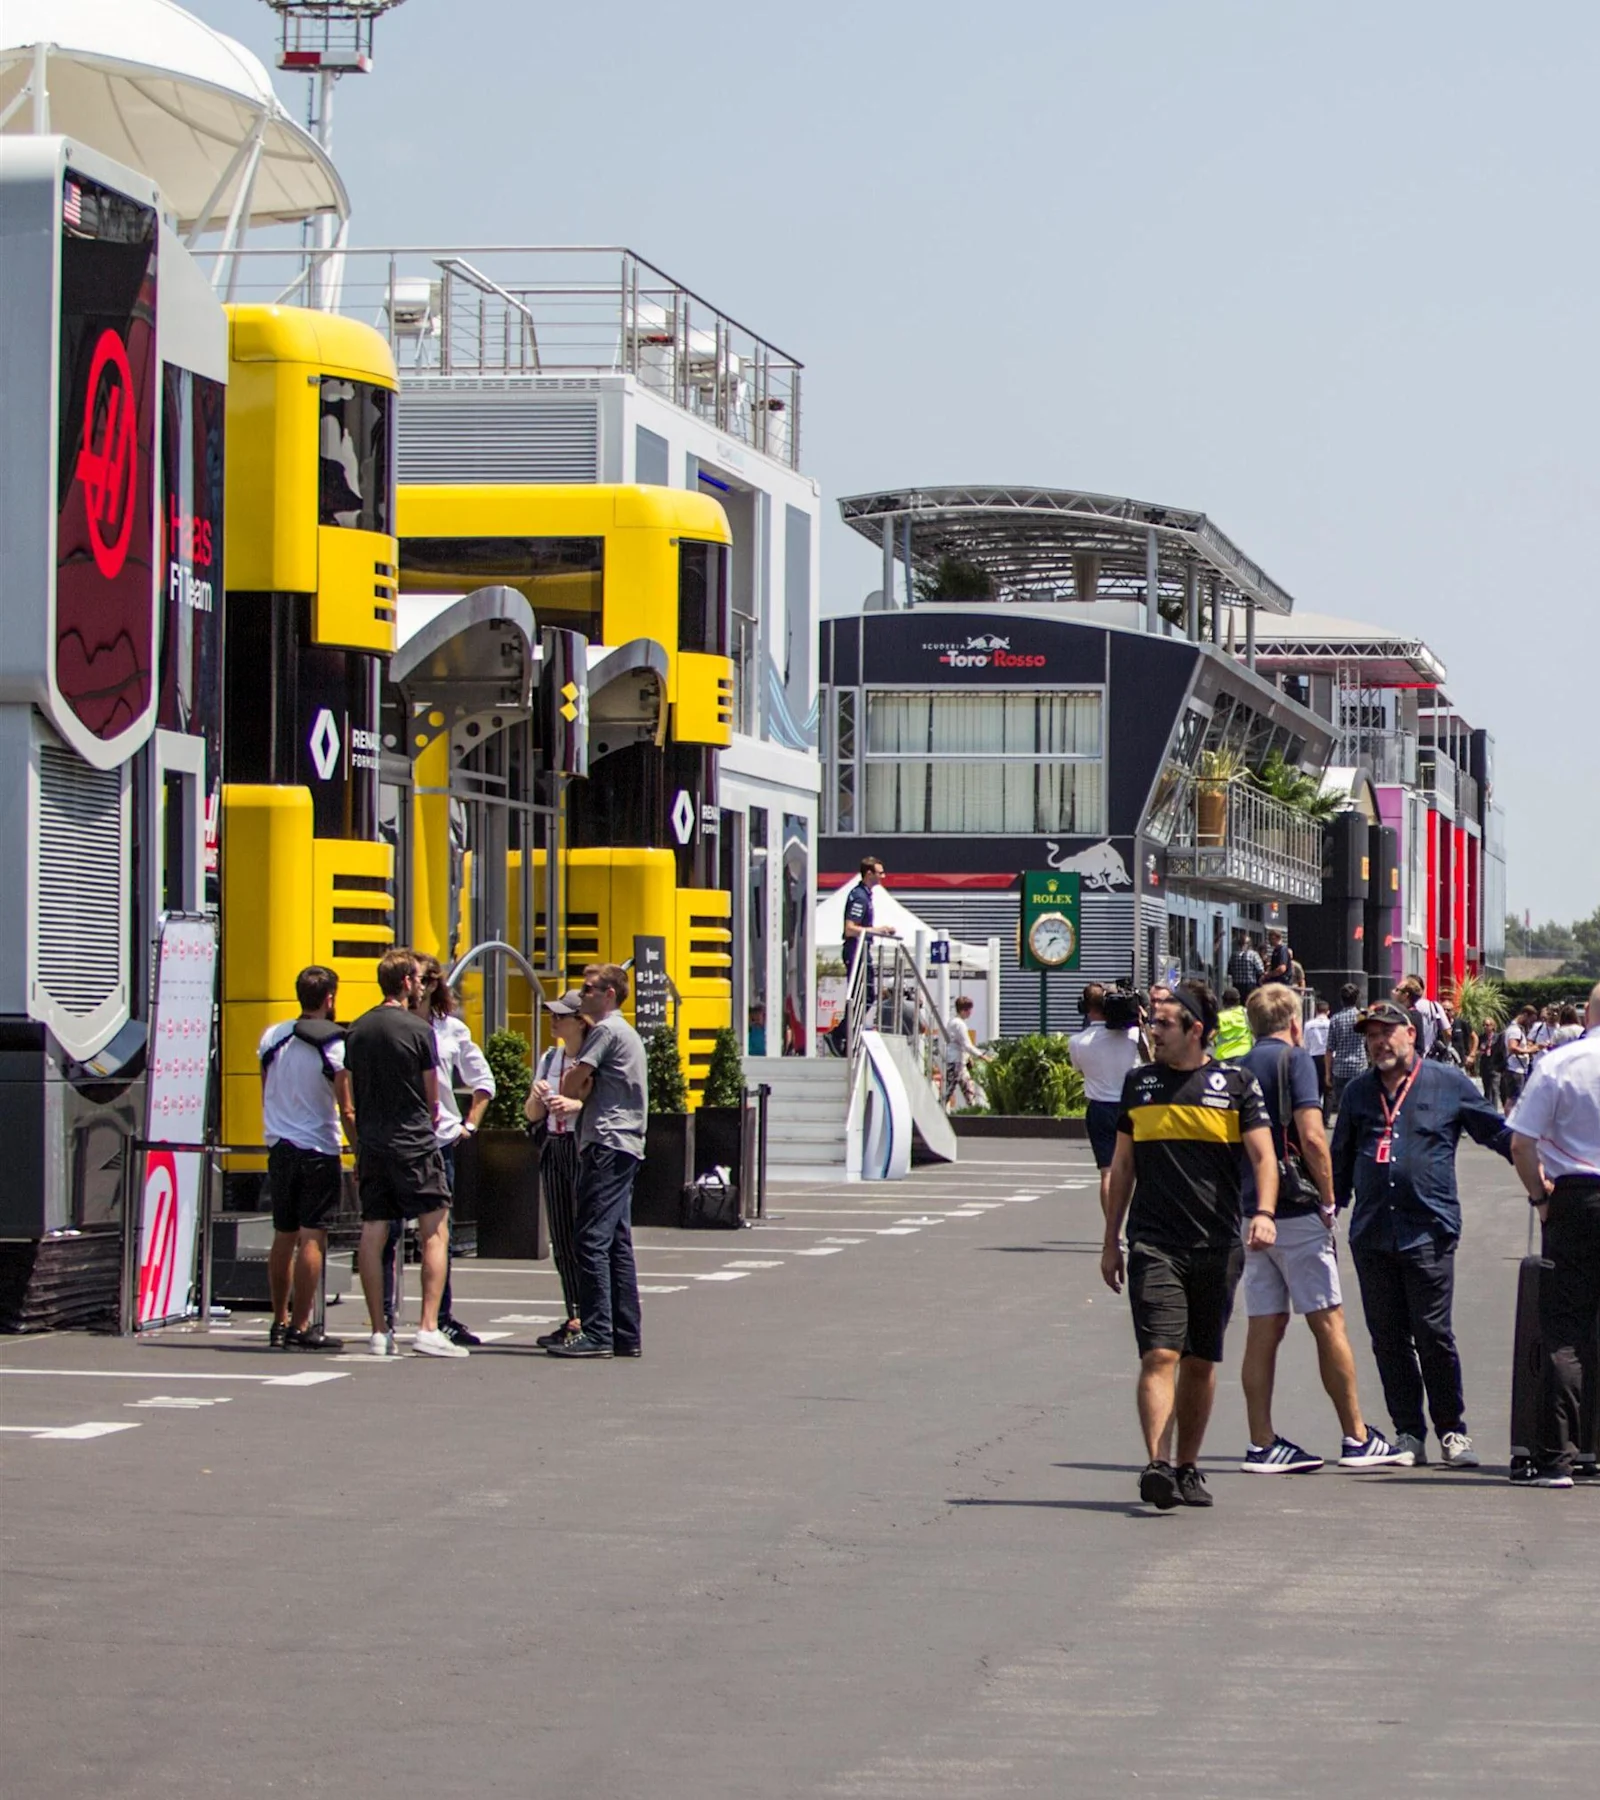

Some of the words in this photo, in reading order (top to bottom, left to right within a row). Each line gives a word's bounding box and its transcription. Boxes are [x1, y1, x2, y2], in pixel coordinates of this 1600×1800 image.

[169, 491, 213, 567] Haas
[946, 650, 988, 667] Toro
[993, 650, 1047, 667] Rosso
[1032, 893, 1073, 905] ROLEX
